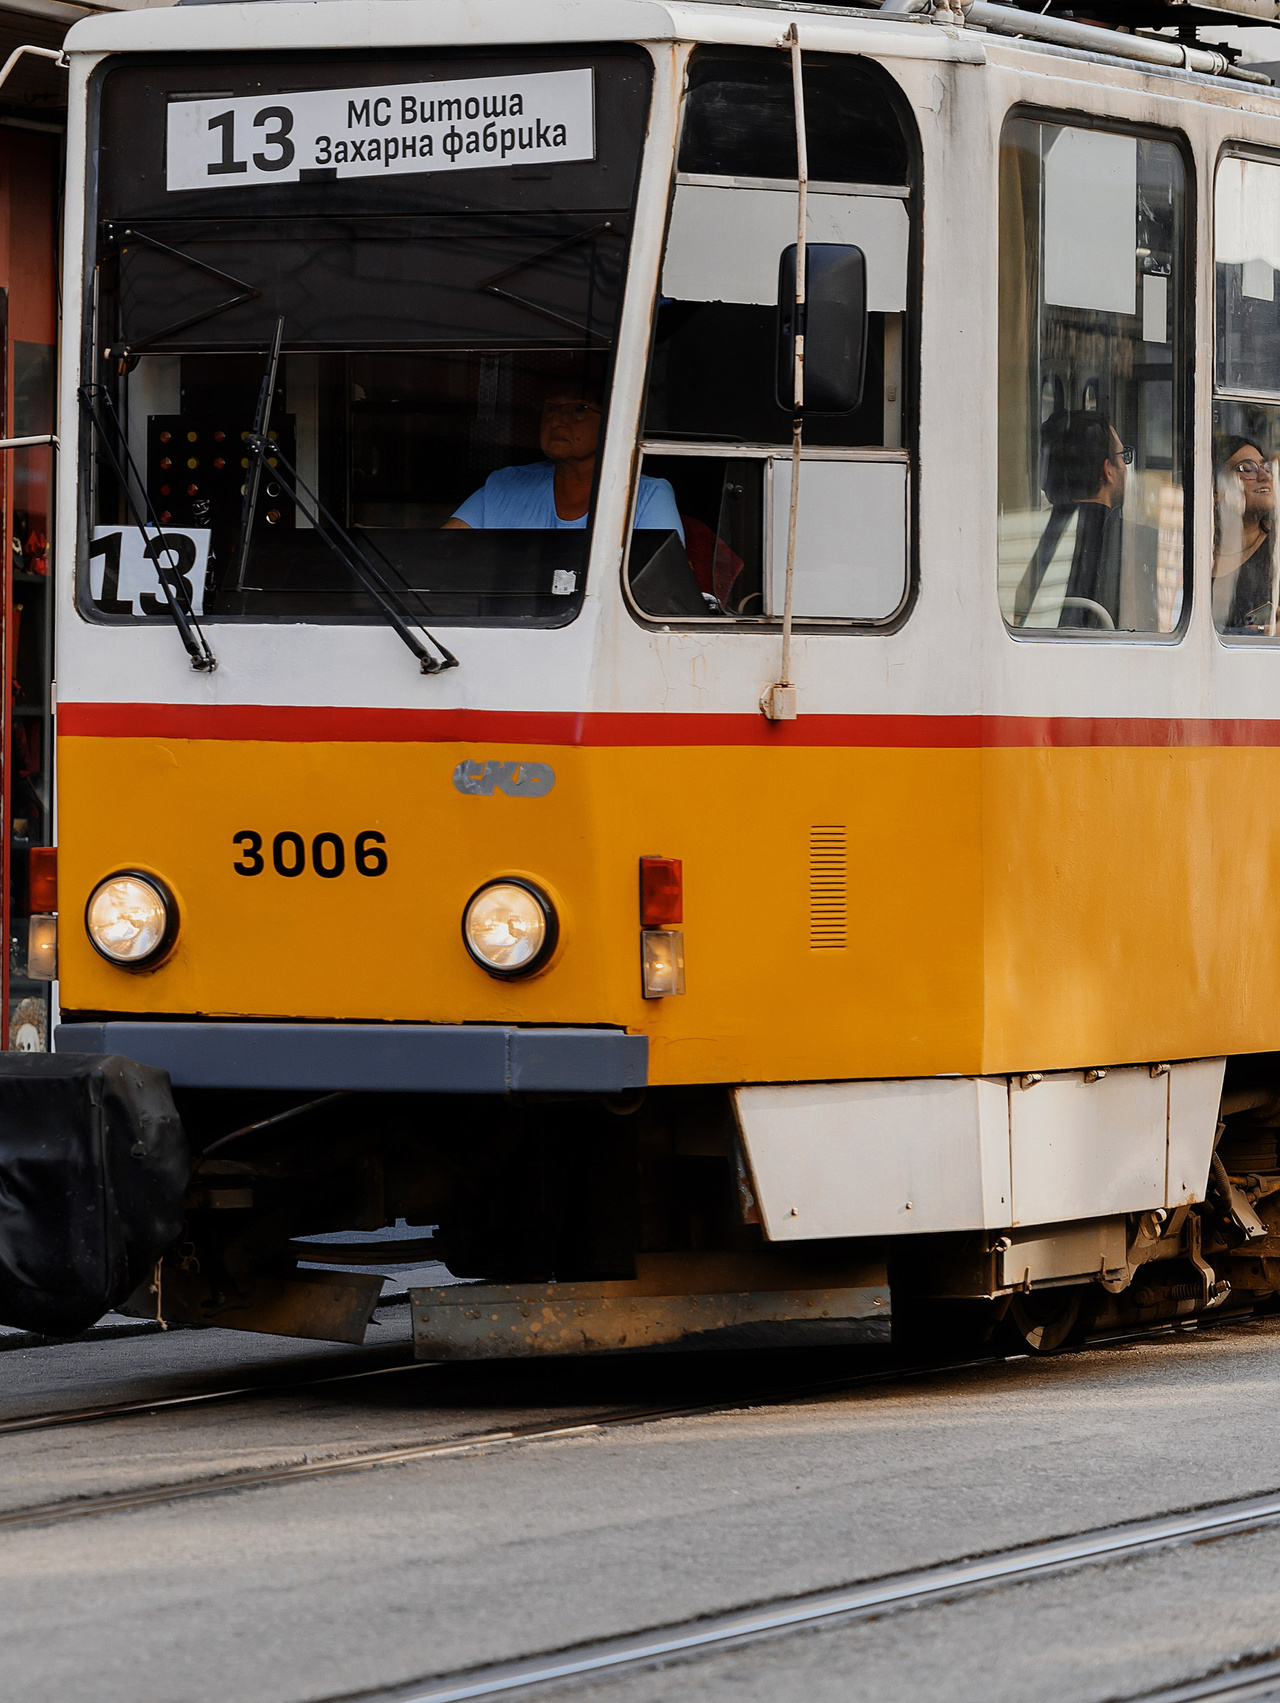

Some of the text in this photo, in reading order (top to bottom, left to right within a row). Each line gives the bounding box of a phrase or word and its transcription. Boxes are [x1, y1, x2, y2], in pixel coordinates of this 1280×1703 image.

[206, 94, 524, 176] 13 МС Витоша
[315, 118, 568, 166] Захарна фабрика
[90, 532, 196, 615] 13
[232, 830, 388, 878] 3006
